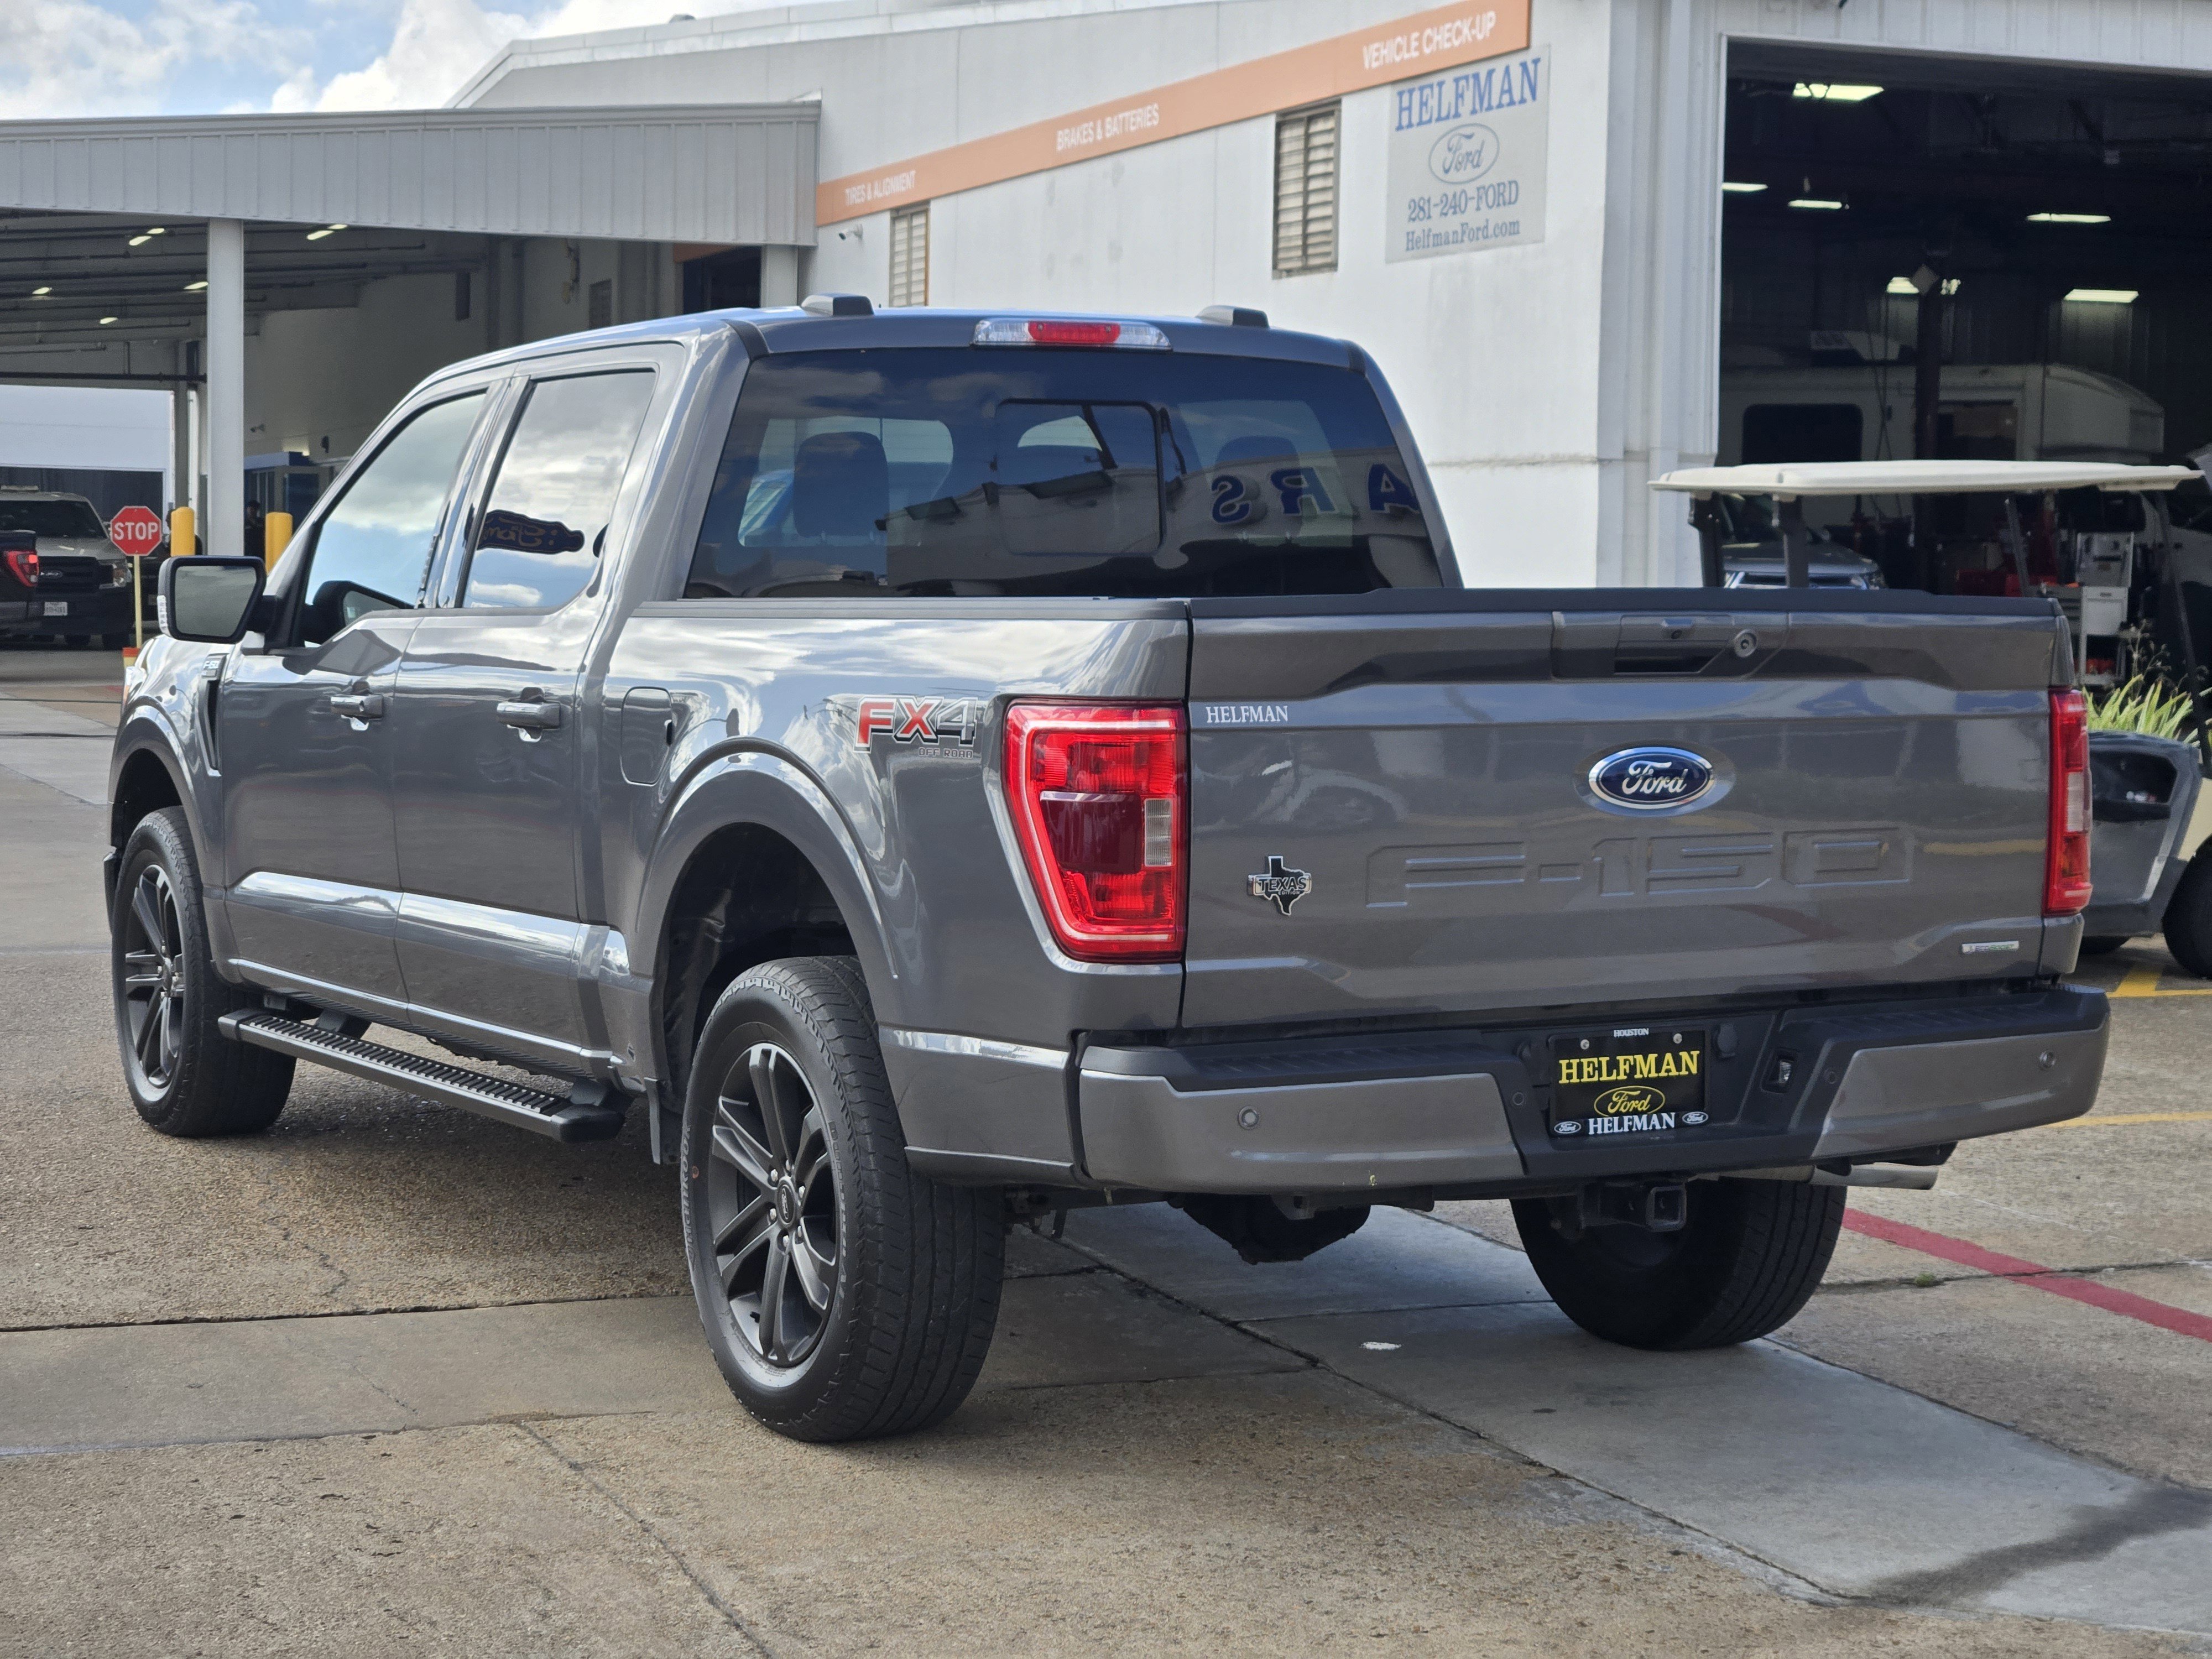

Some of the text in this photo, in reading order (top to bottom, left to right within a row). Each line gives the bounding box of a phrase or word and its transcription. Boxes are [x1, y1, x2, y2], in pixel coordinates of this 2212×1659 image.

[1363, 10, 1496, 70] VEHICLE CHECK-UP
[1395, 58, 1541, 132] HELFMAN
[1056, 103, 1160, 151] BRAKES & BATTERIES
[1442, 133, 1486, 174] Ford
[845, 184, 866, 206] TIRES
[874, 169, 916, 199] ALIGNMENT
[1408, 180, 1519, 222] 281-240-FORD
[1406, 218, 1520, 251] HelfmanFord.com
[114, 522, 158, 540] STOP
[853, 696, 978, 754] FX4
[1206, 705, 1288, 723] HELFMAN
[919, 747, 974, 759] OFF ROAD
[1621, 760, 1689, 795] Ford
[1258, 877, 1307, 891] TEXAS
[1366, 827, 1912, 907] F-150
[1614, 1027, 1650, 1038] HOUSTON
[1558, 1050, 1700, 1084] HELFMAN
[1607, 1089, 1651, 1114] Ford
[1588, 1112, 1677, 1135] HELFMAN
